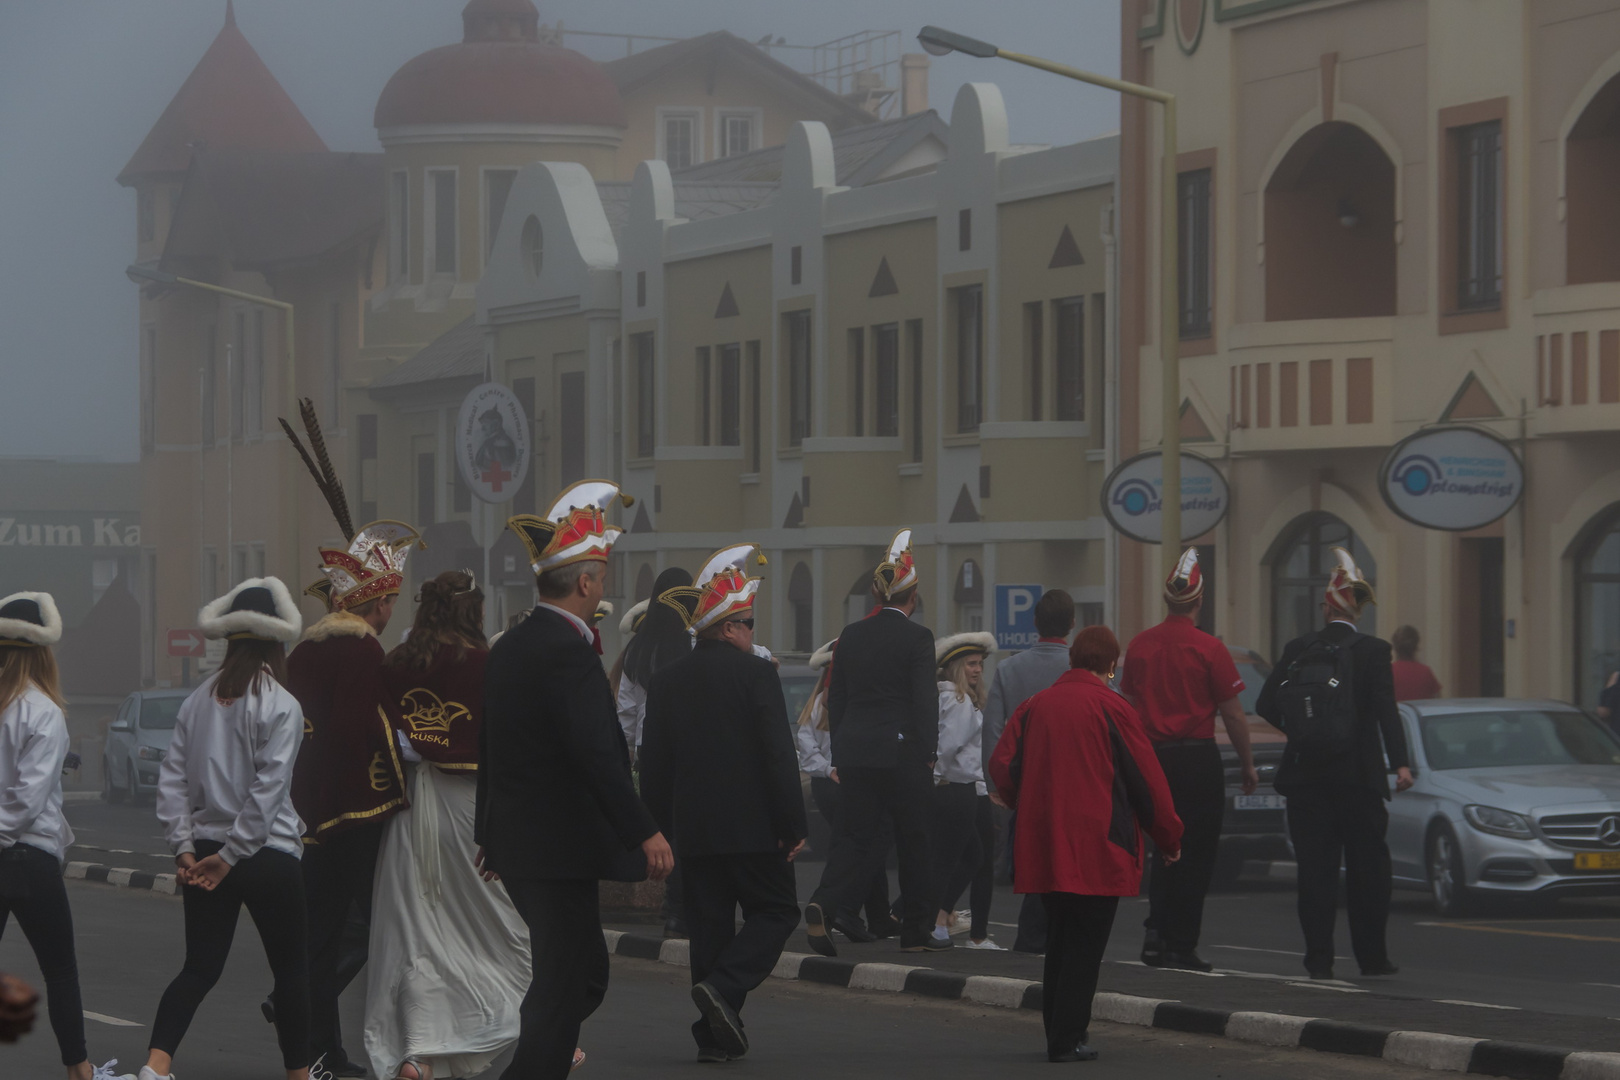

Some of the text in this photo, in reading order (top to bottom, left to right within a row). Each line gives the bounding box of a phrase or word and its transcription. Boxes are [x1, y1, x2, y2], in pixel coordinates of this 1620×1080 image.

[466, 404, 478, 436] Medical
[478, 389, 505, 401] Centre
[507, 401, 523, 441] Pharmacy
[0, 517, 141, 546] Zum Ka
[1007, 588, 1034, 626] P
[410, 731, 449, 748] KÜSKA
